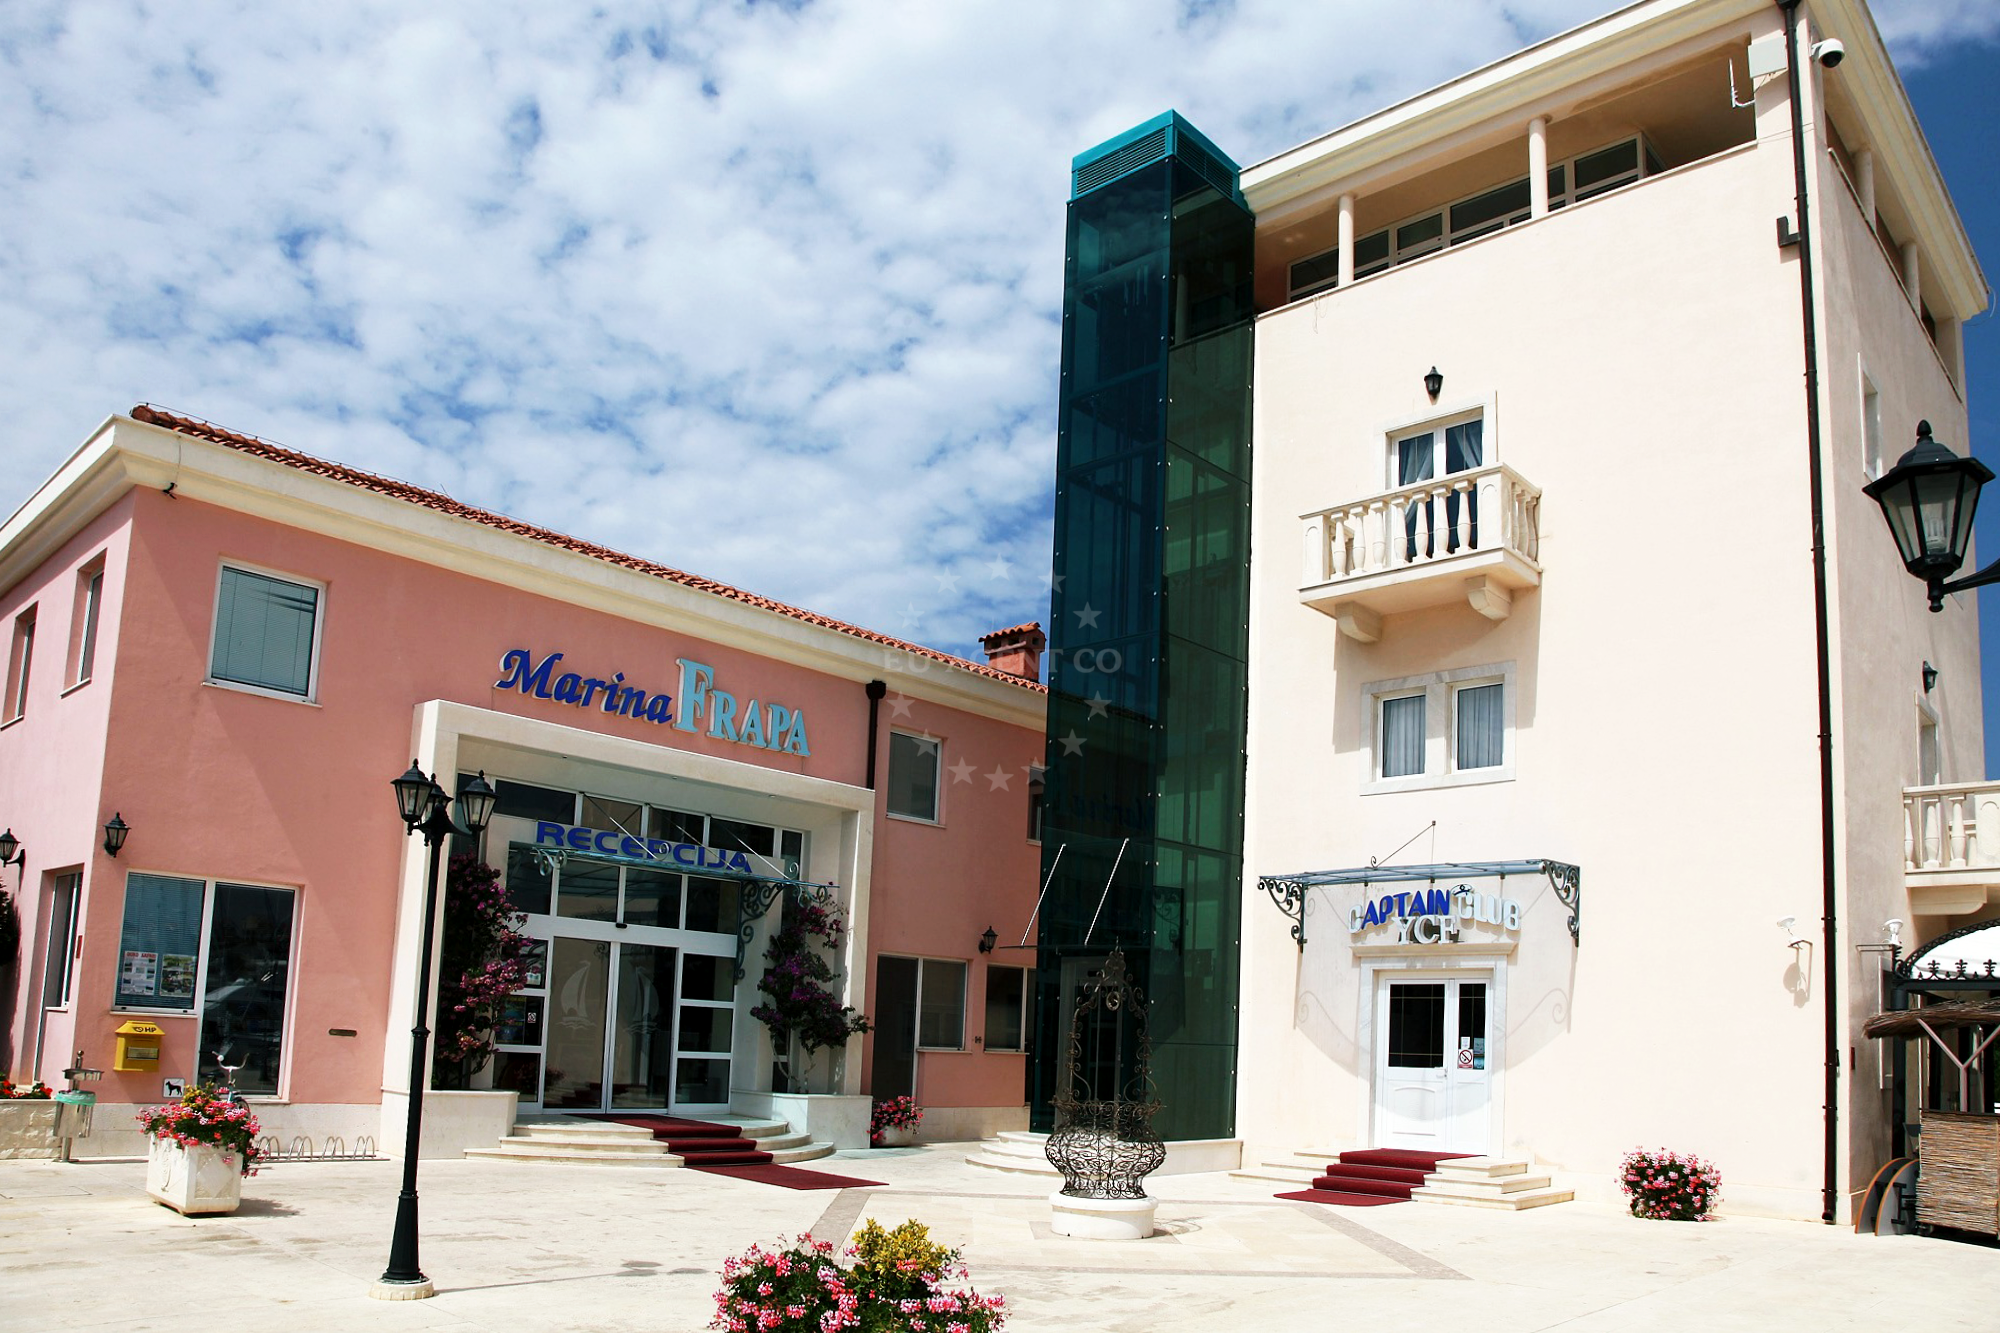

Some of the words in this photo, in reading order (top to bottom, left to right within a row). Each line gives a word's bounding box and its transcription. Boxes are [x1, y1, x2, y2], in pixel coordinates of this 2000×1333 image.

[493, 649, 673, 724] Marina
[672, 658, 810, 757] FRAPA
[536, 822, 753, 873] RECEPCIJA
[1348, 889, 1451, 934] CAPTAIN
[1457, 893, 1520, 931] CLUB
